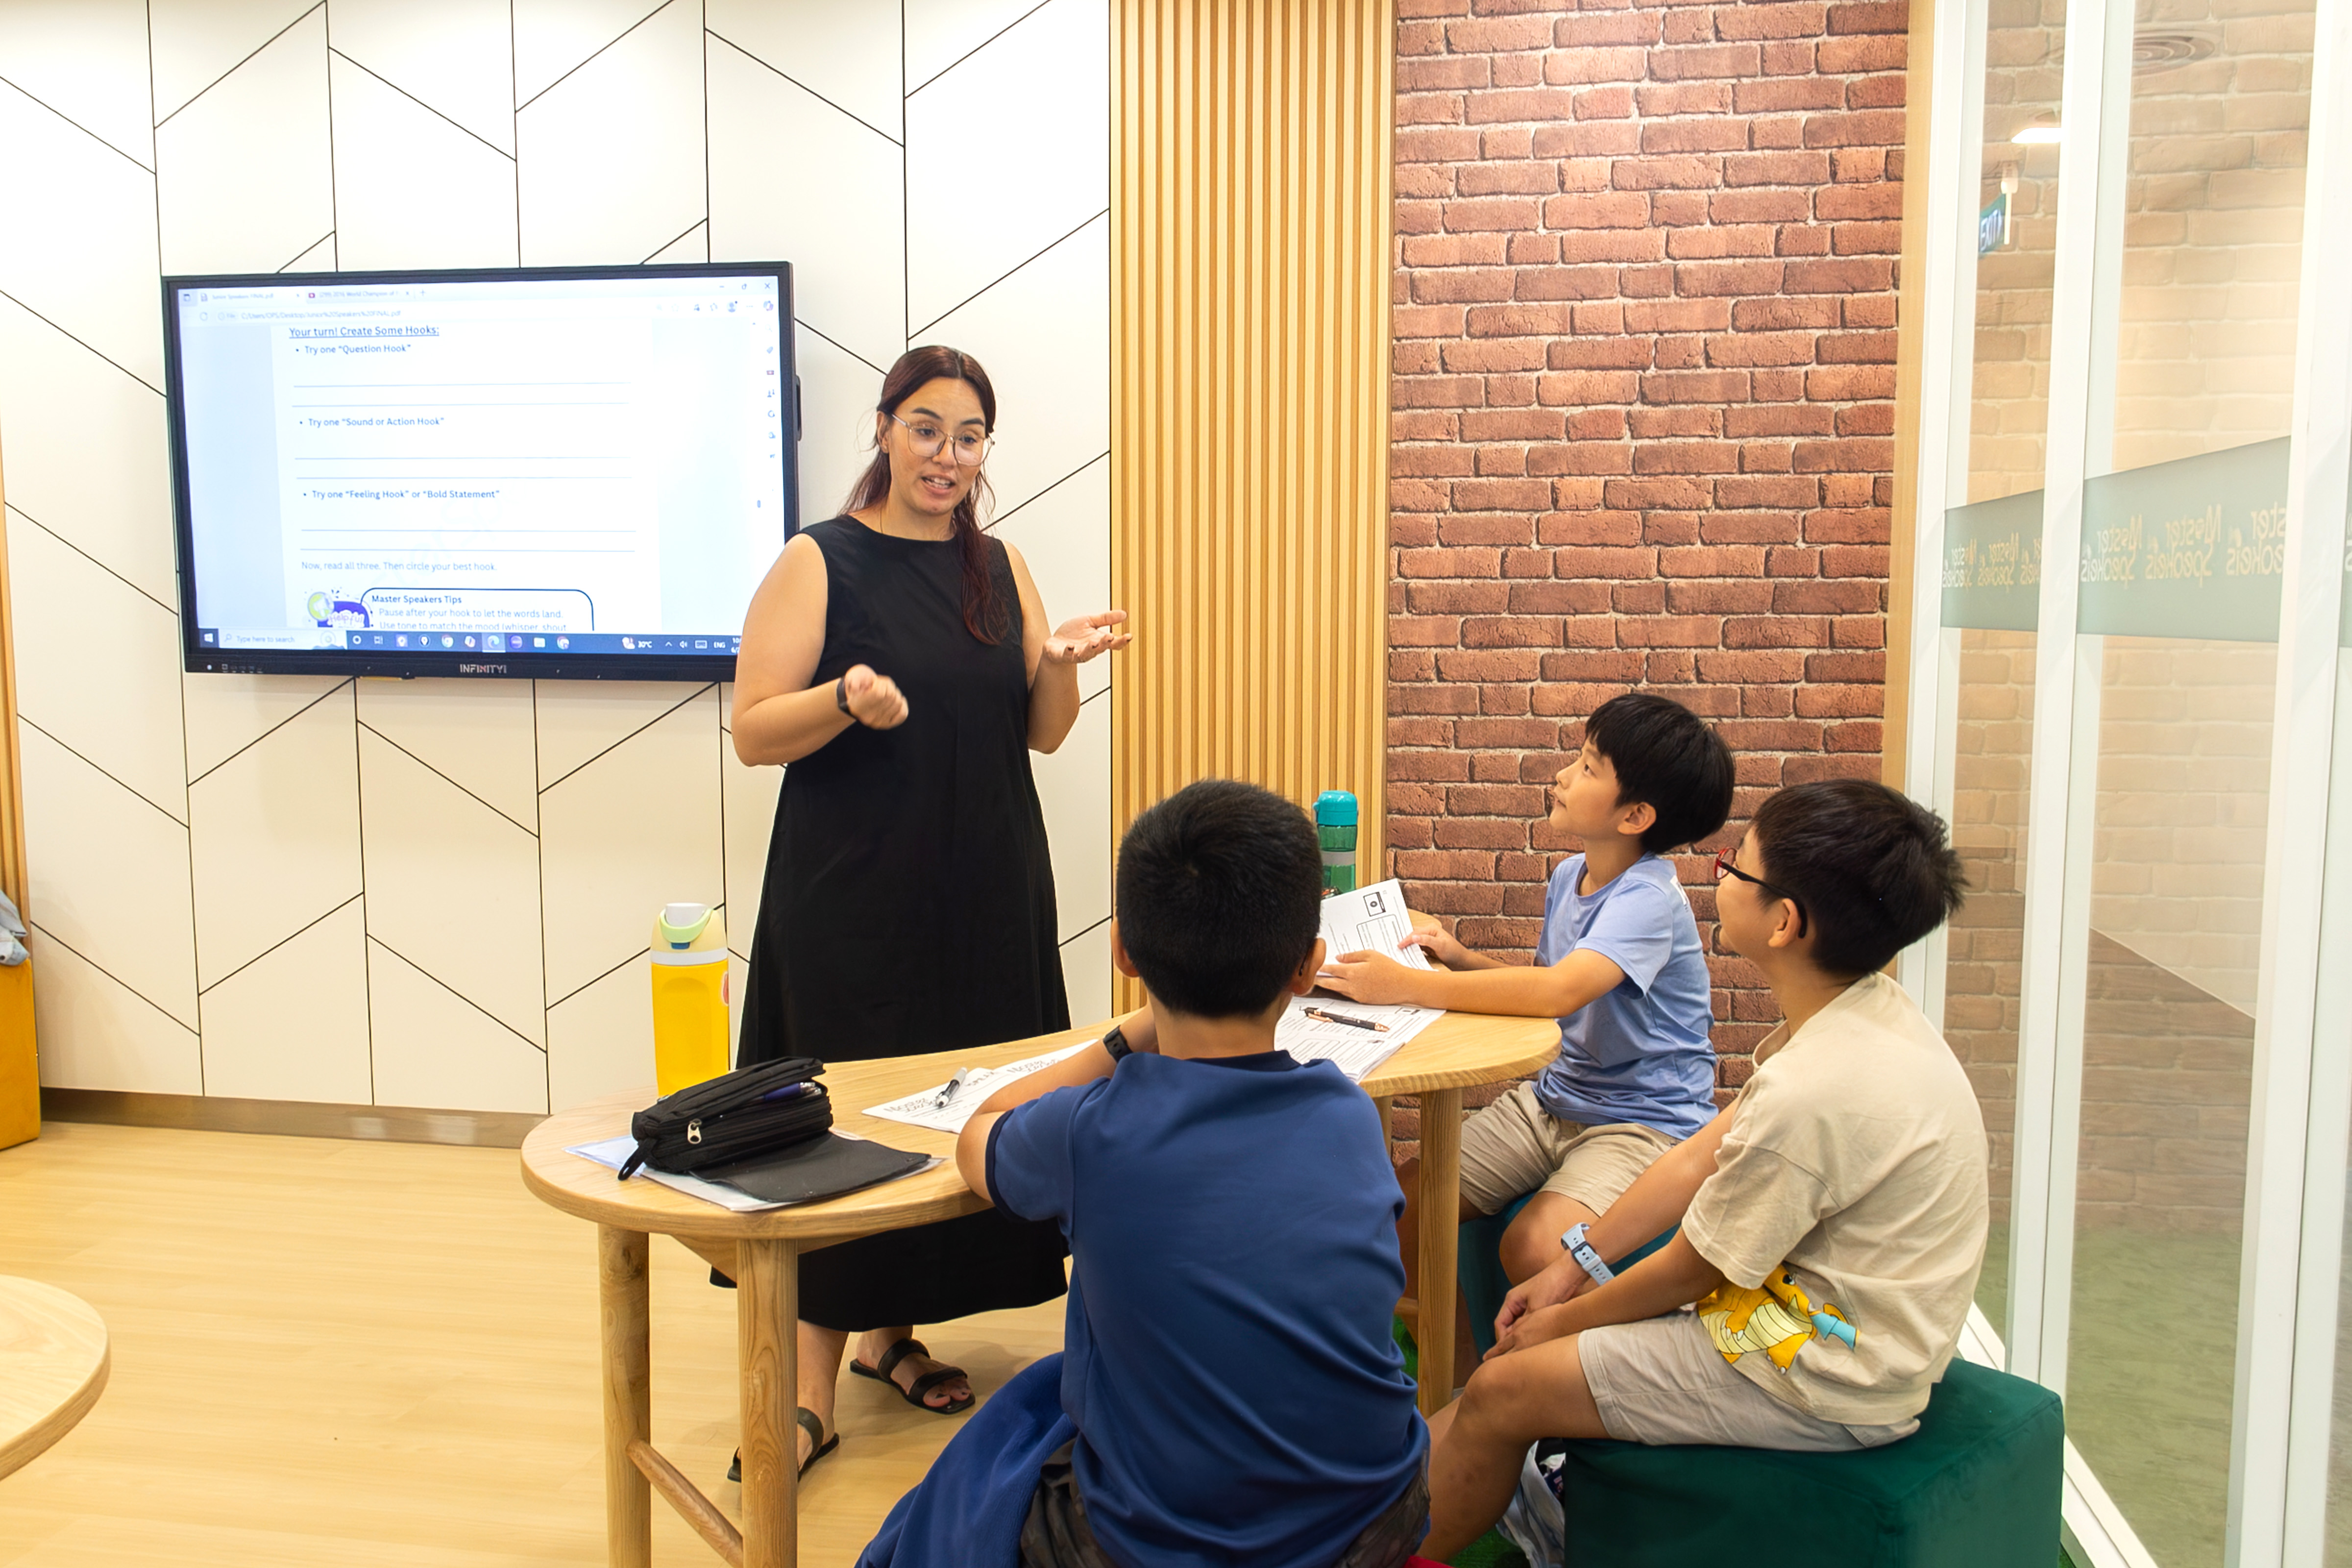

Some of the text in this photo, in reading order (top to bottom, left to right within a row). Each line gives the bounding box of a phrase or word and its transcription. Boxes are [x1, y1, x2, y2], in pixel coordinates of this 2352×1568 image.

[289, 328, 312, 337] Your
[314, 327, 338, 337] turn!
[340, 327, 373, 336] Create
[375, 326, 403, 336] Some
[305, 346, 318, 355] Try
[308, 418, 321, 428] Try
[312, 490, 325, 500] Try
[302, 562, 322, 571] Now,
[356, 562, 381, 570] three.
[383, 562, 404, 570] Then
[406, 562, 429, 570] circle
[431, 564, 451, 573] your
[453, 563, 472, 571] best
[474, 563, 497, 571] hook.
[403, 595, 442, 605] Speakers
[444, 596, 462, 605] Tips
[379, 608, 404, 616] Pause
[406, 608, 426, 616] after
[329, 614, 364, 625] Helpful
[236, 635, 250, 643] Type
